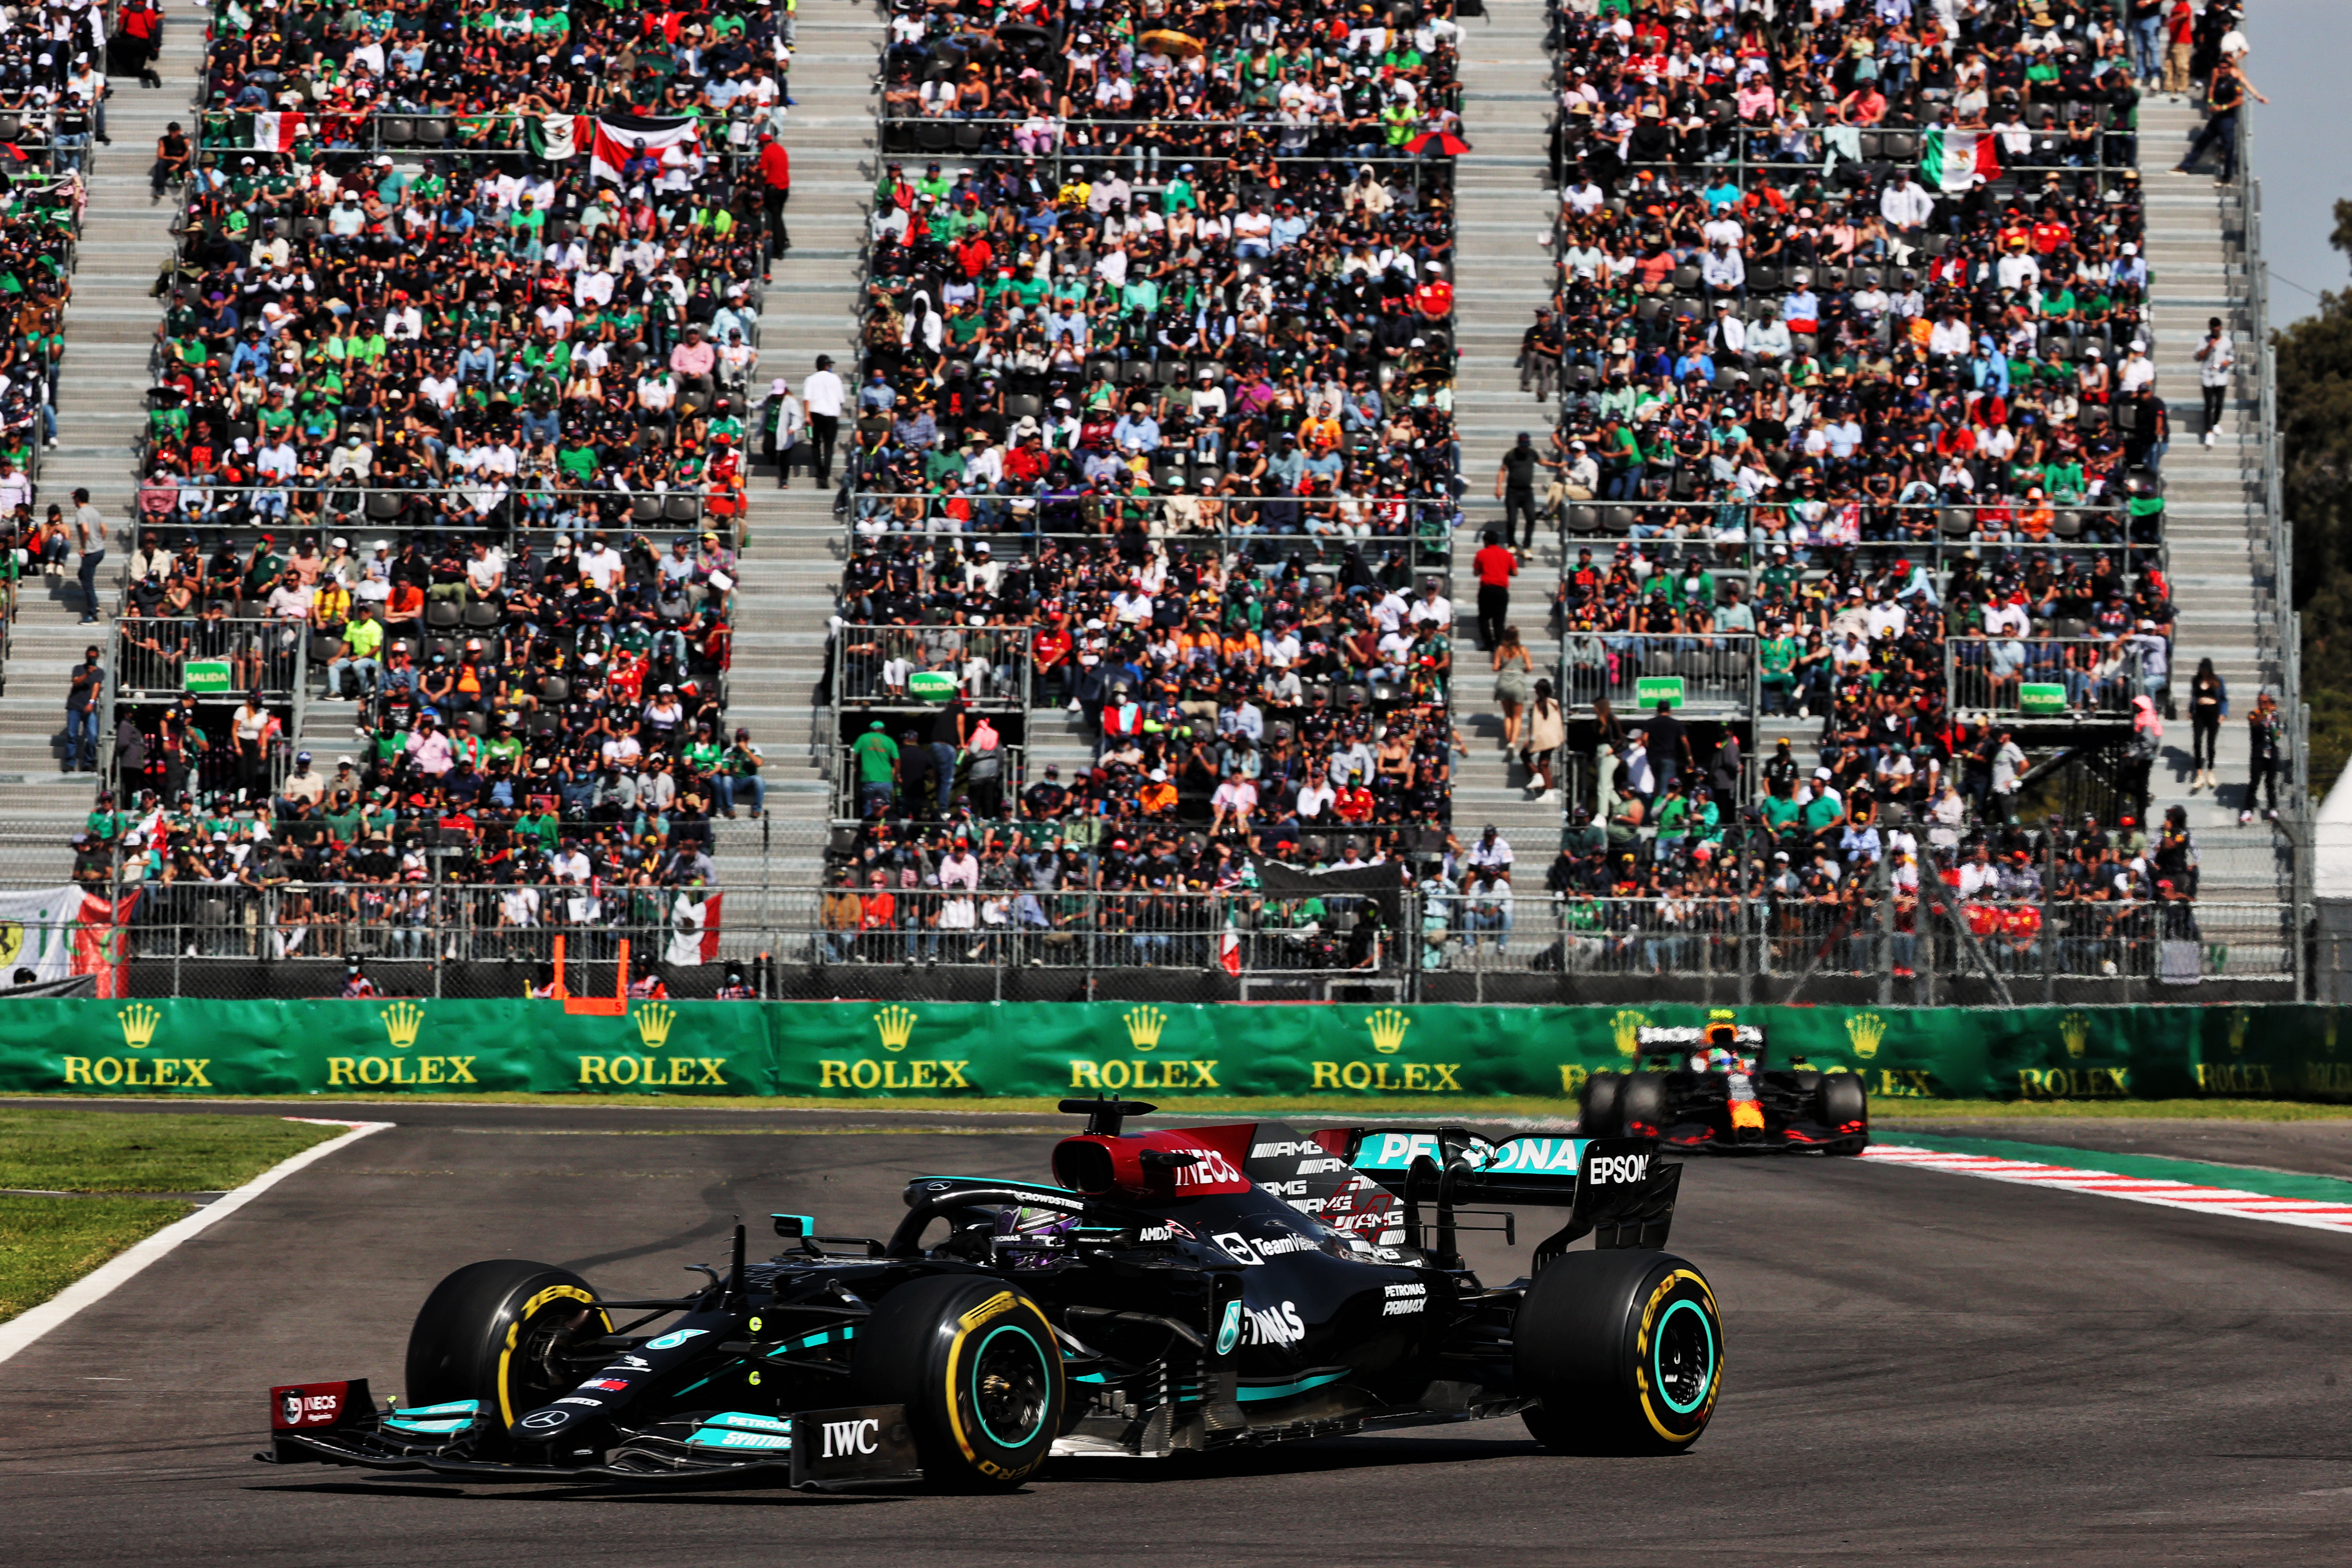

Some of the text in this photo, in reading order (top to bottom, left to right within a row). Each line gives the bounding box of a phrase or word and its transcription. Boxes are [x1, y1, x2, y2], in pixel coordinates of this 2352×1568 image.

[186, 672, 227, 682] SALIDA
[913, 682, 953, 692] SALIDA
[1640, 688, 1681, 698] SALIDA
[2022, 694, 2063, 703] SALIDA
[615, 1002, 622, 1012] 5
[63, 1056, 213, 1087] ROLEX
[327, 1056, 478, 1085] ROLEX
[578, 1056, 728, 1086] ROLEX
[819, 1059, 969, 1089] ROLEX
[1069, 1060, 1220, 1089] ROLEX
[1311, 1061, 1464, 1091] ROLEX
[2019, 1068, 2131, 1096] ROLEX
[2195, 1063, 2272, 1092] ROLEX
[1171, 1149, 1240, 1186] INEOS
[1590, 1155, 1650, 1185] EPSON
[1020, 1192, 1084, 1210] CROWDSTRIKE
[1140, 1227, 1167, 1241] AMD
[1250, 1233, 1322, 1256] TeamViewer
[1385, 1284, 1426, 1298] PETRONAS
[1382, 1295, 1428, 1316] PRIMAX
[304, 1396, 336, 1411] INEOS
[822, 1419, 879, 1458] IWC
